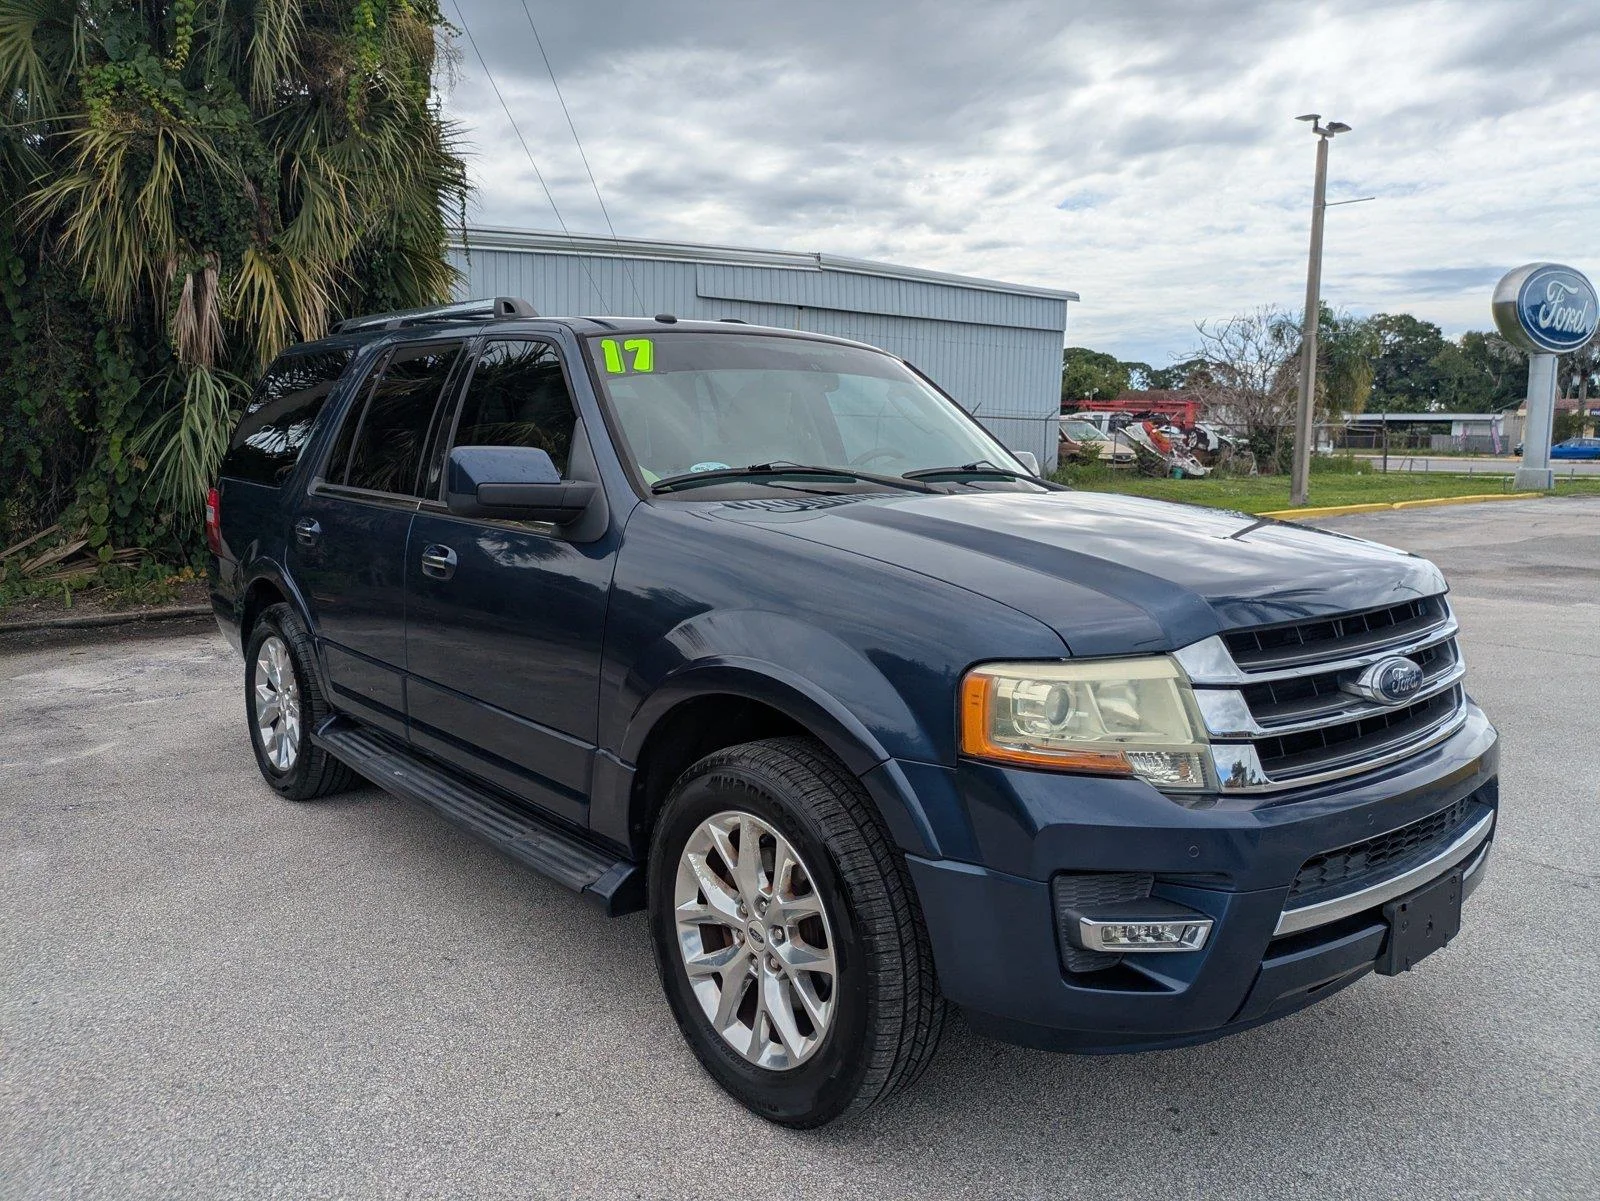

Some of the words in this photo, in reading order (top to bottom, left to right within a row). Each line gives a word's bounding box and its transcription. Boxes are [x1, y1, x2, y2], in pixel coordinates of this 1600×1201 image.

[1538, 280, 1588, 334] Ford
[601, 338, 654, 374] 17
[1391, 666, 1418, 694] Ford
